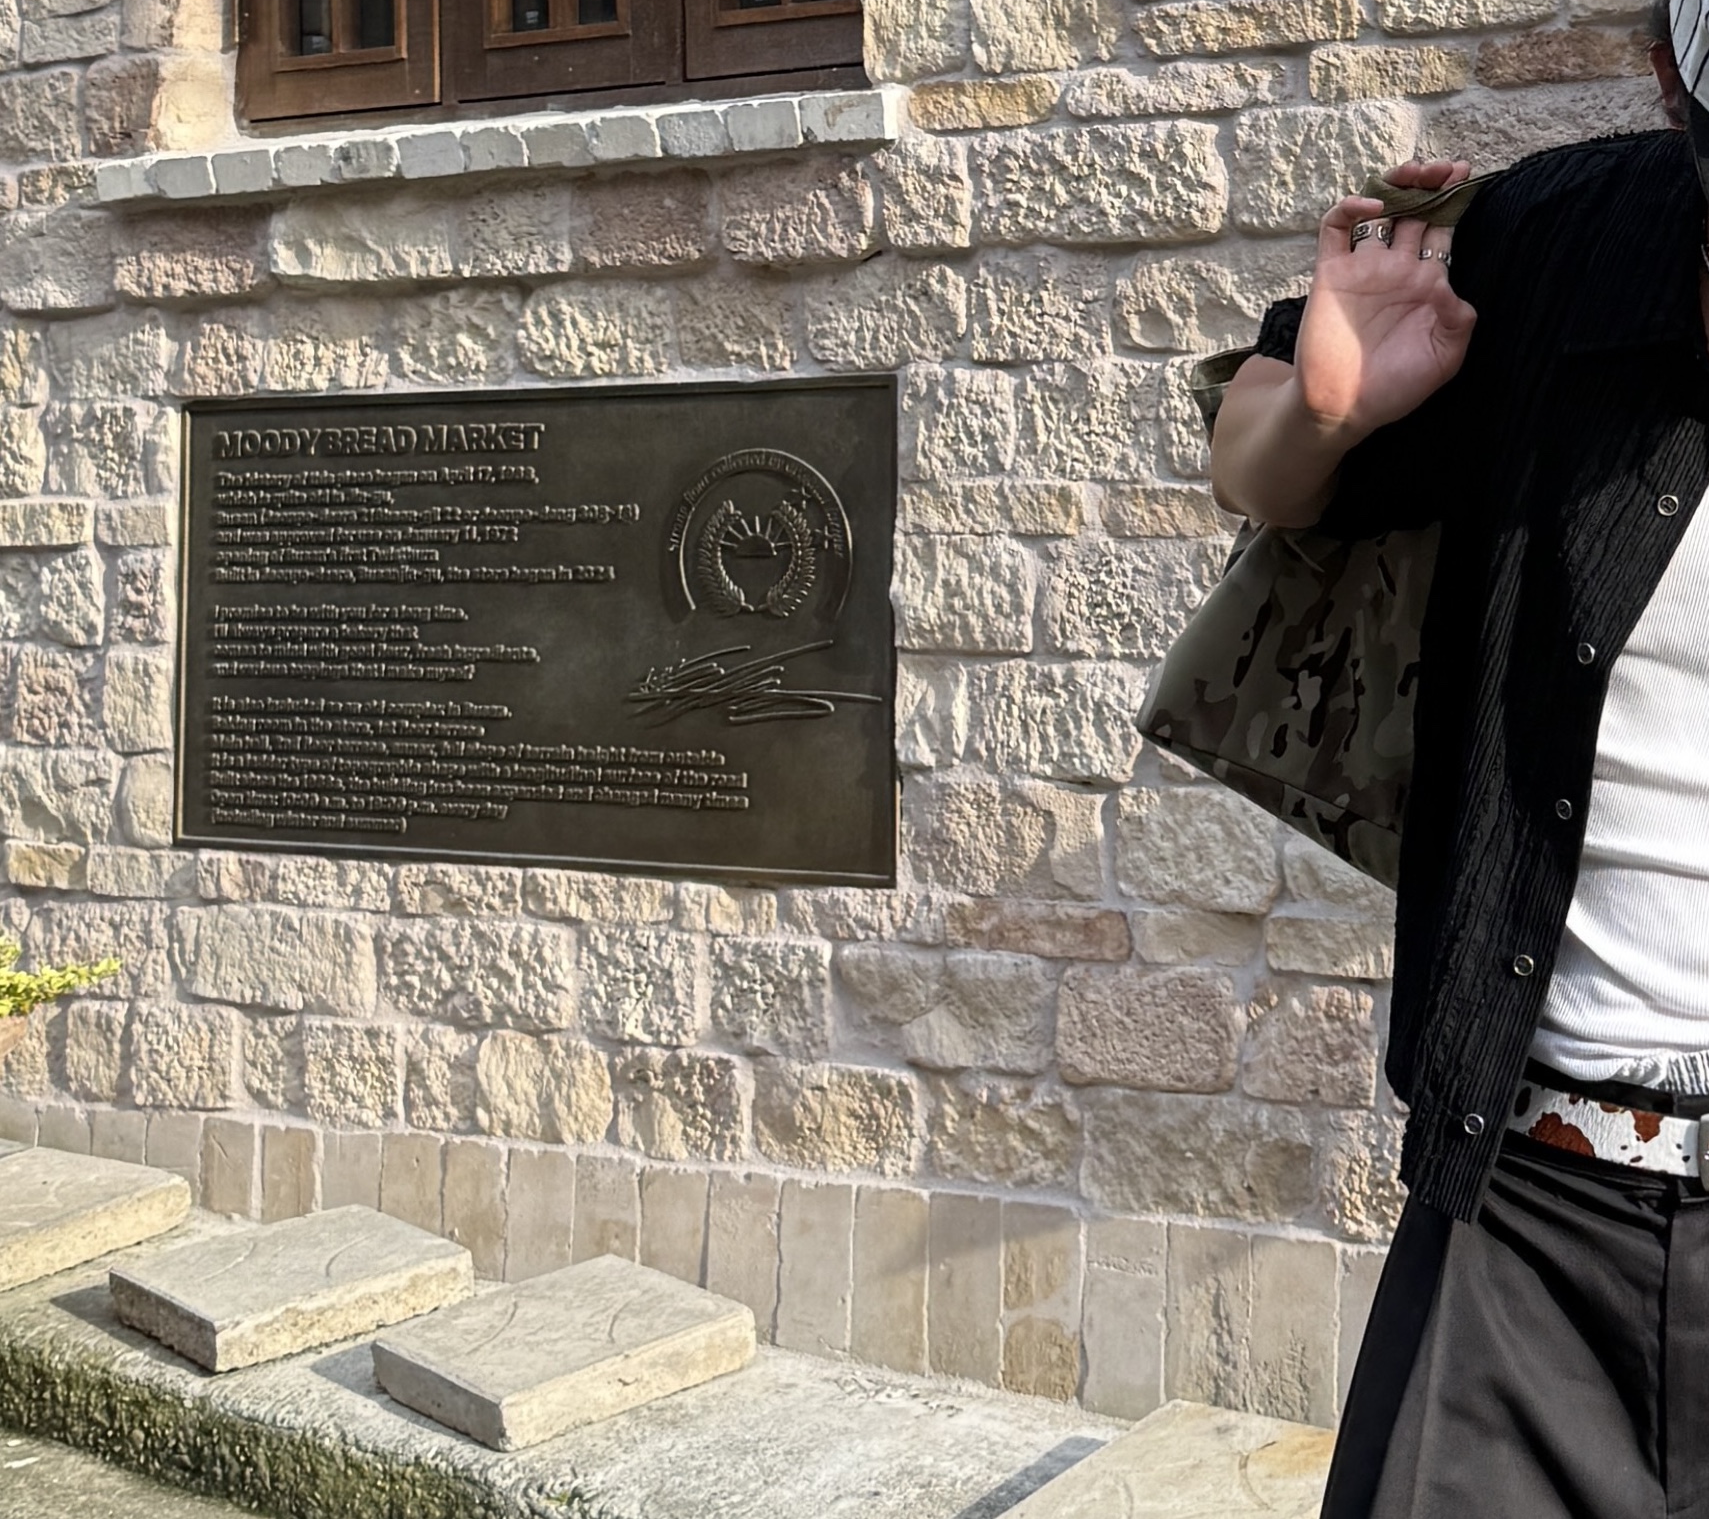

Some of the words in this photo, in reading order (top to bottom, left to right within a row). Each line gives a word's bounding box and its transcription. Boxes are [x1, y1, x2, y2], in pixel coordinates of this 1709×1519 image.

[213, 429, 321, 459] MOODY
[322, 425, 417, 455] BREAD
[420, 422, 546, 452] MARKET
[438, 468, 473, 485] April
